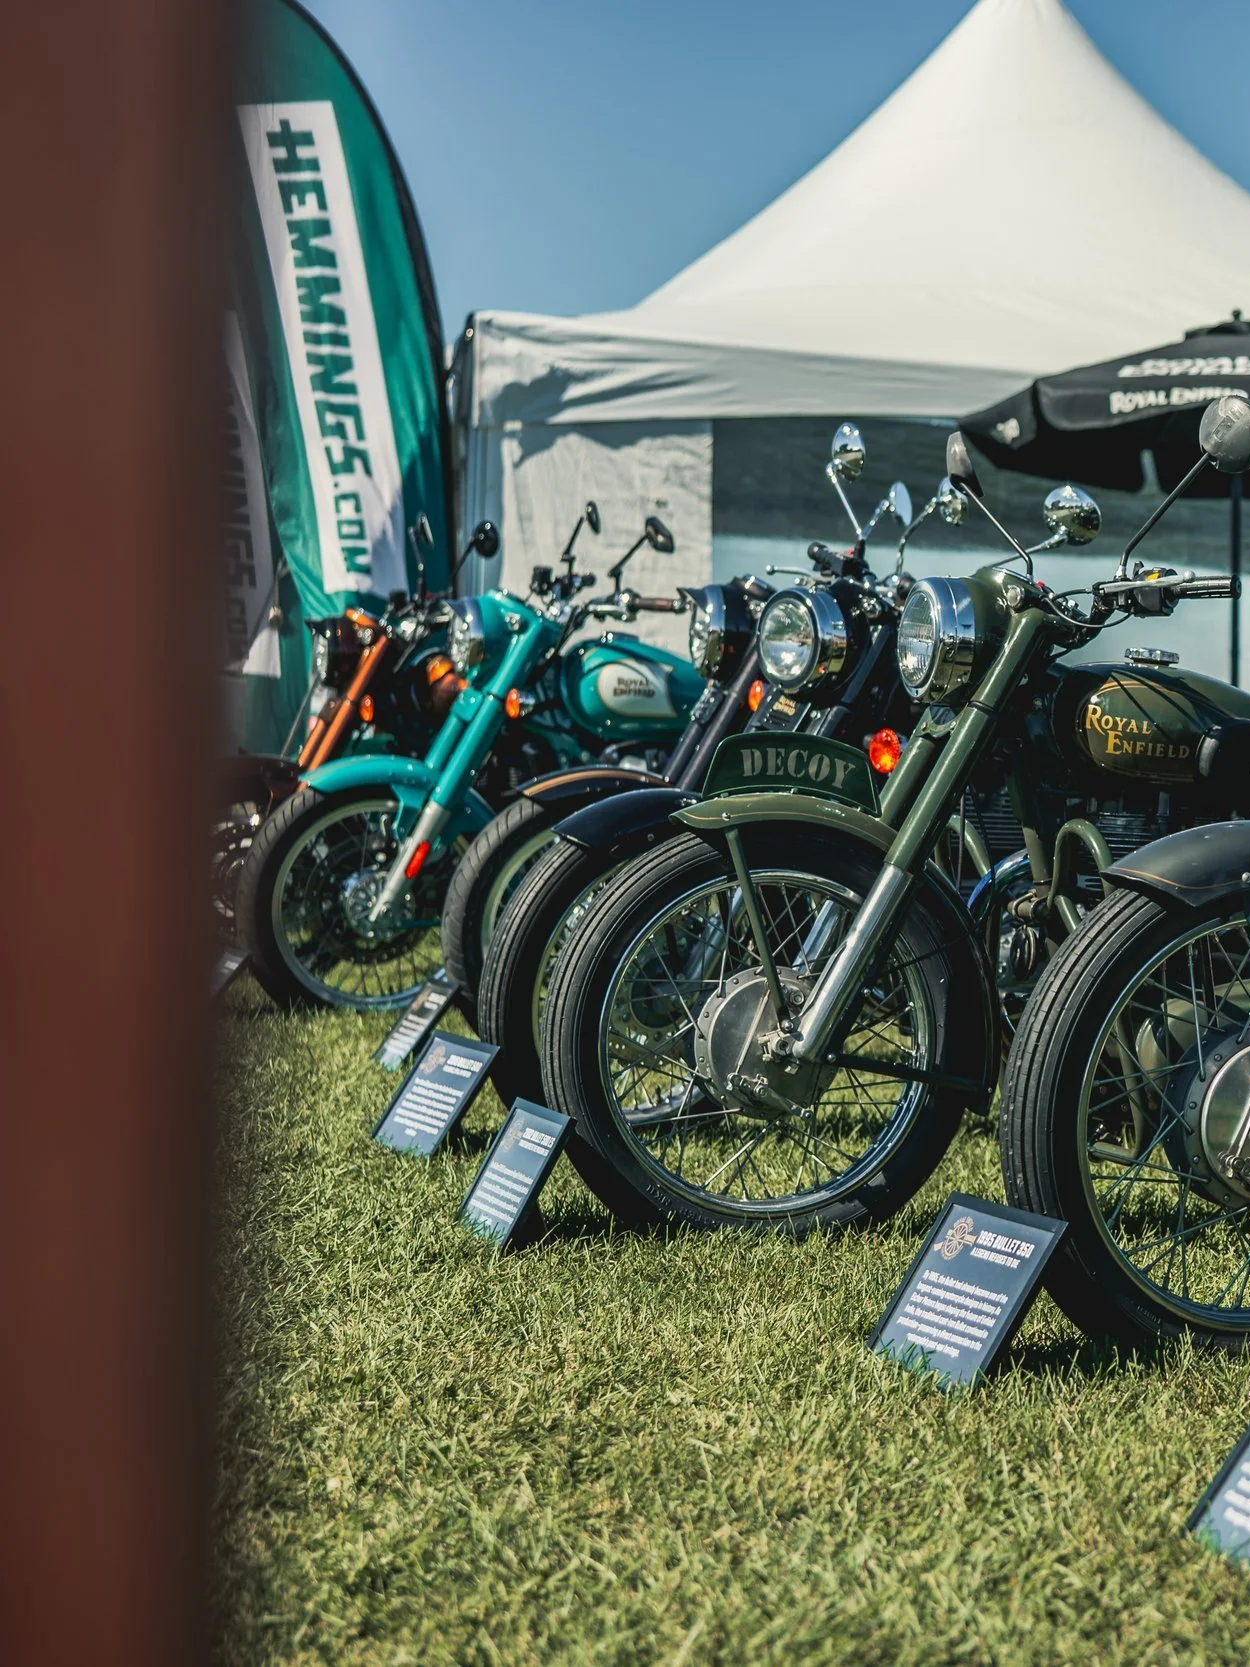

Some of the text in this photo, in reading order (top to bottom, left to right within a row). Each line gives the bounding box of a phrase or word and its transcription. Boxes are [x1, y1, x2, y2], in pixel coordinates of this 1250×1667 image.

[266, 119, 373, 574] HEMMINGS.COM
[1110, 390, 1167, 414] ROYAL
[1085, 704, 1152, 736] ROYAL
[1106, 730, 1190, 759] ENFIELD
[740, 748, 856, 789] DECOY
[976, 1230, 1035, 1258] 1995 BULLET 350
